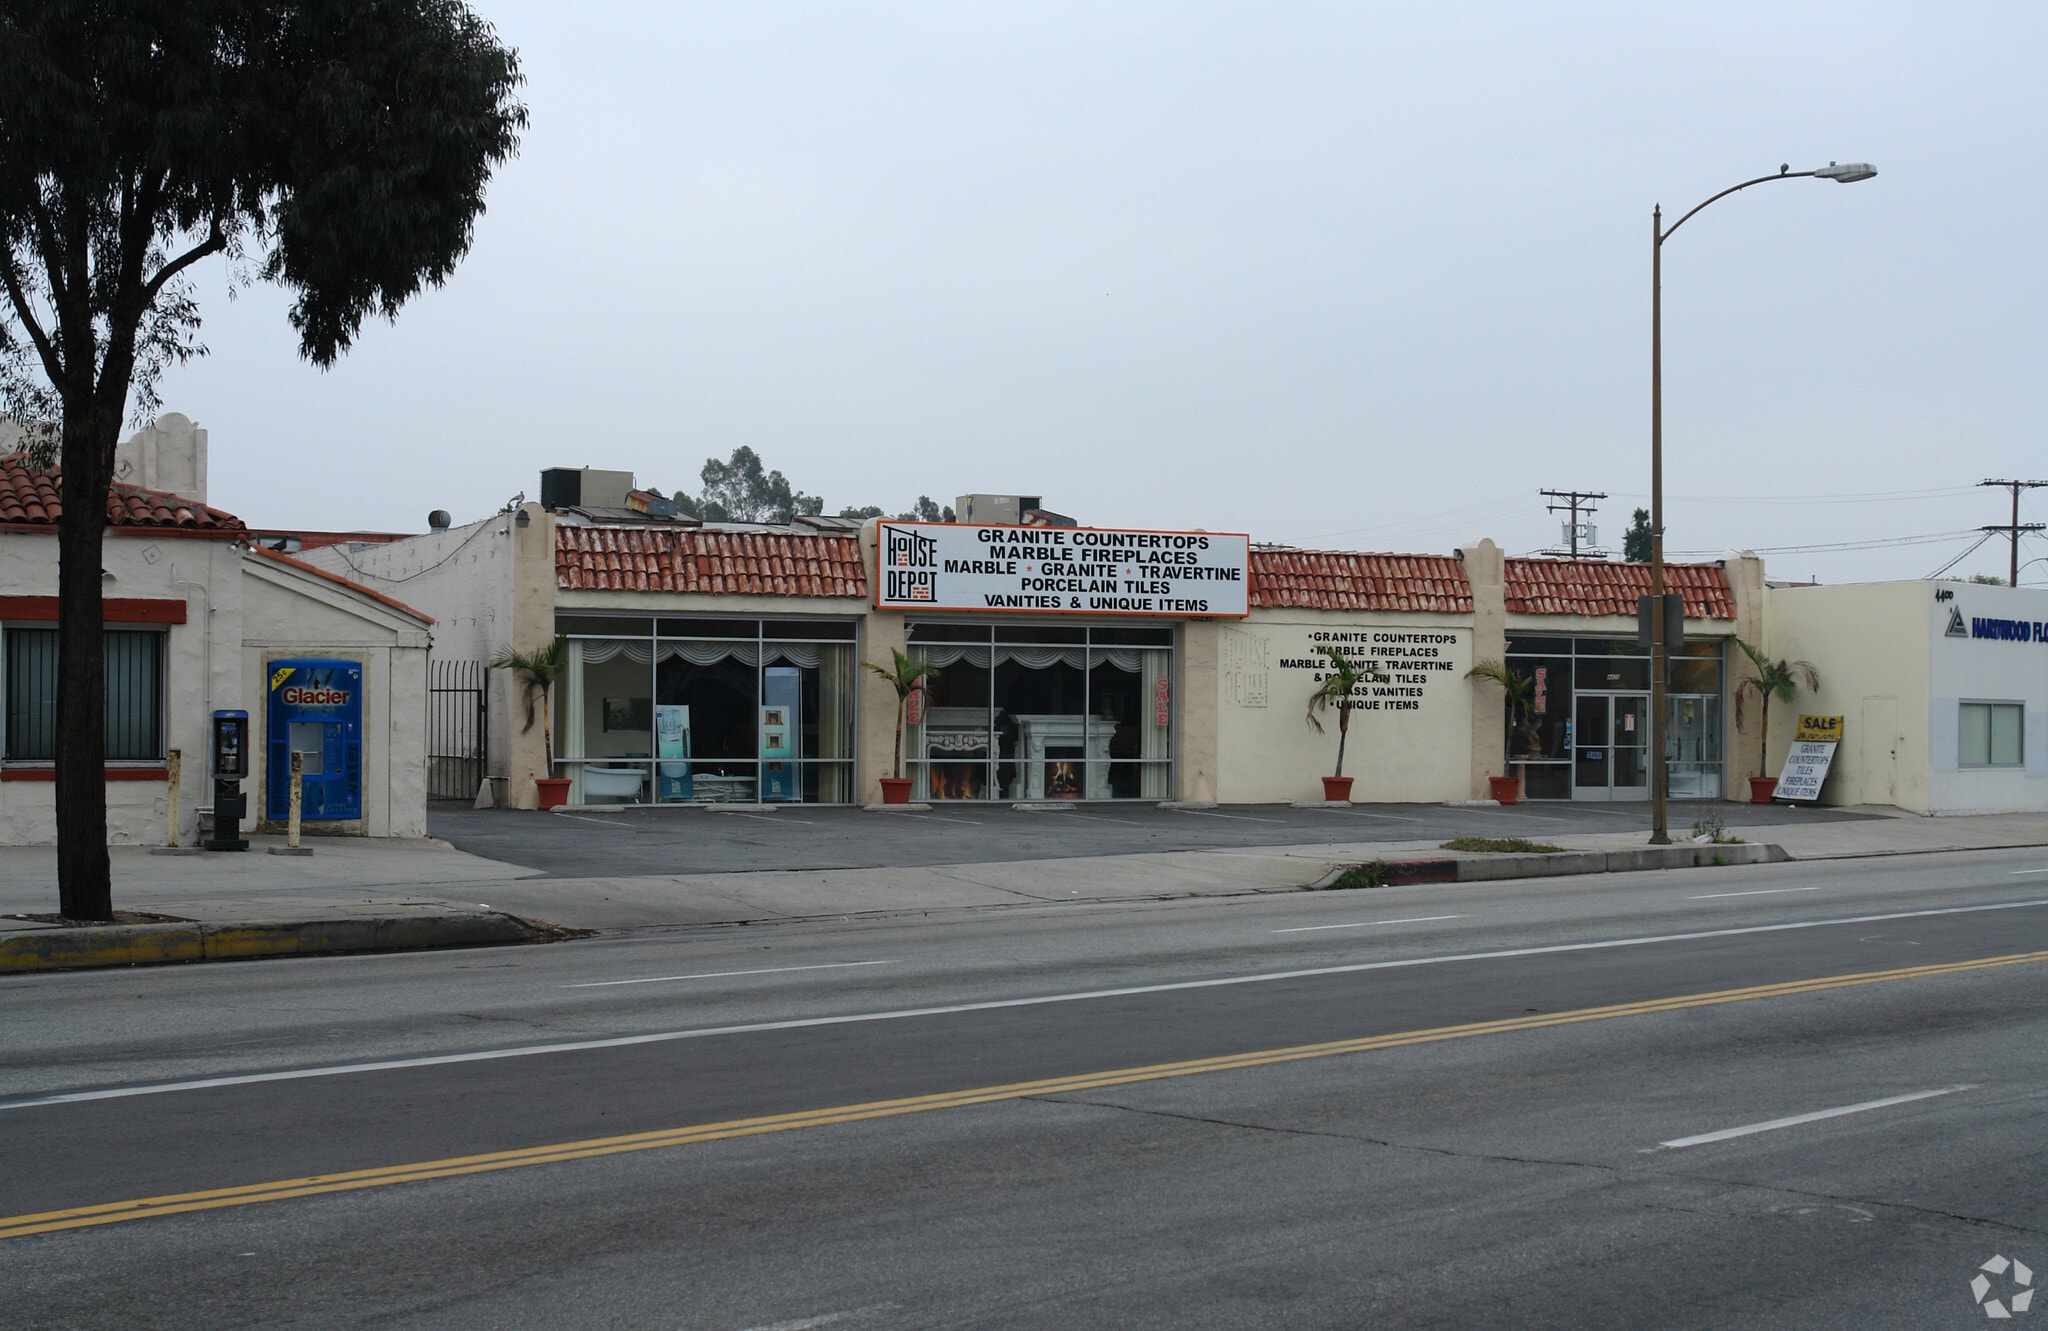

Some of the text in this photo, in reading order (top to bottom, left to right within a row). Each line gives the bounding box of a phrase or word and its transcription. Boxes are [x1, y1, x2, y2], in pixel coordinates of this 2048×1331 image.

[978, 529, 1209, 549] GRANITE COUNTERTOPS
[887, 527, 937, 567] HOUSE
[990, 546, 1198, 564] MARBLE FIREPLACES
[945, 560, 1241, 581] MARBLE GRANITE TRAVERTINE
[887, 570, 938, 598] DEPOT
[1021, 578, 1170, 594] PORCELAIN TILES
[985, 594, 1208, 611] VANITIES & UNIQUE ITEMS
[1935, 589, 1954, 603] 4400
[1972, 617, 2031, 642] HARDWOOD
[1314, 632, 1457, 644] GRANITE COUNTERTOPS
[1317, 646, 1438, 657] MARBLE FIREPLACES
[1280, 659, 1325, 669] MARBLE
[1386, 661, 1453, 671] TRAVERTINE
[1314, 673, 1427, 684] & POELAIN TILES
[283, 687, 350, 704] Glacier
[1331, 687, 1423, 697] LASS VANITIES
[1535, 668, 1546, 713] SALE
[1157, 680, 1168, 725] SALE
[1385, 701, 1419, 710] ITEMS
[1804, 717, 1836, 730] SALE
[1800, 744, 1826, 753] GRANITE
[1788, 755, 1830, 764] COUNTERTOPS
[346, 744, 359, 796] water
[1796, 766, 1814, 775] TILES
[1785, 776, 1818, 786] FIREPLACES
[1777, 787, 1818, 797] UNIQUE ITEMS
